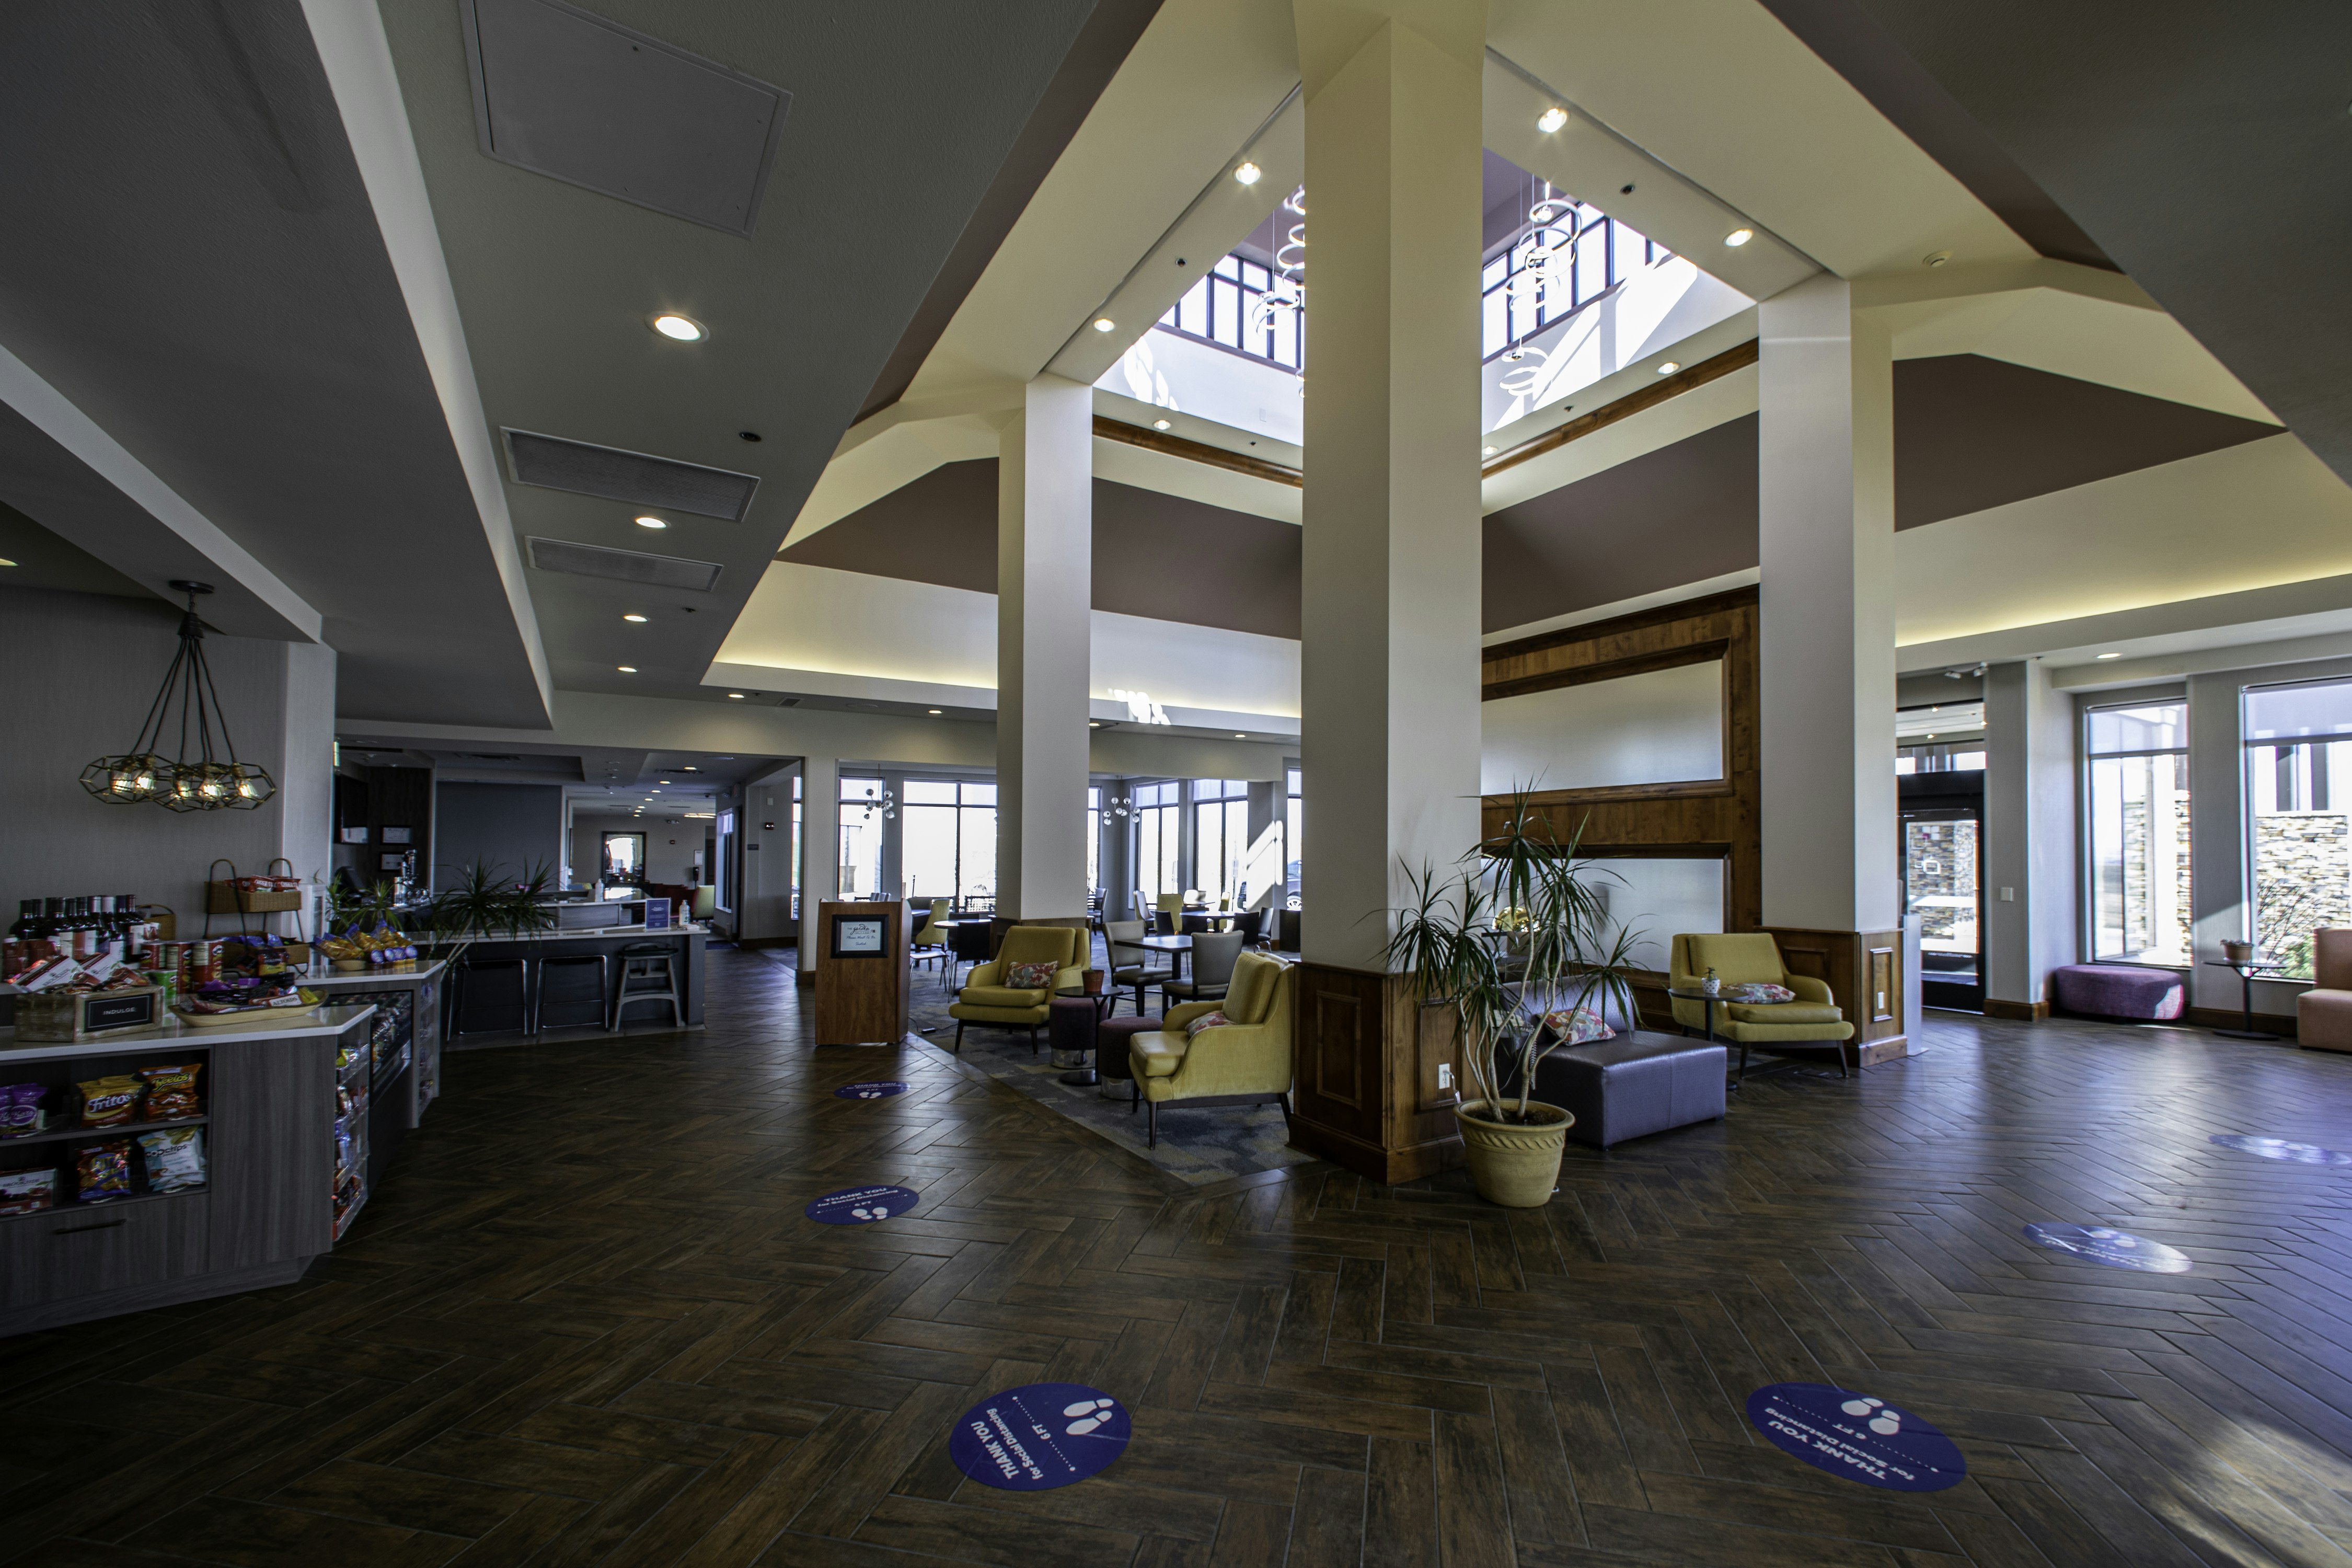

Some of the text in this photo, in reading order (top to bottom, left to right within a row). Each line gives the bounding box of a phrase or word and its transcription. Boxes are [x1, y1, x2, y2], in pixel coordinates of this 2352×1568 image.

[102, 1007, 137, 1016] INDULGE
[87, 1094, 131, 1113] Fritos
[146, 1144, 189, 1158] popchips
[824, 1192, 862, 1202] THANK
[857, 1190, 898, 1200] Distancing
[1032, 1423, 1048, 1435] FT
[1832, 1423, 1867, 1440] 6 FT
[971, 1421, 1020, 1480] THANK YOU
[986, 1408, 1045, 1480] for Social Distancing
[1765, 1407, 1916, 1481] for Social Distancing
[1767, 1421, 1887, 1480] THANK YOU
